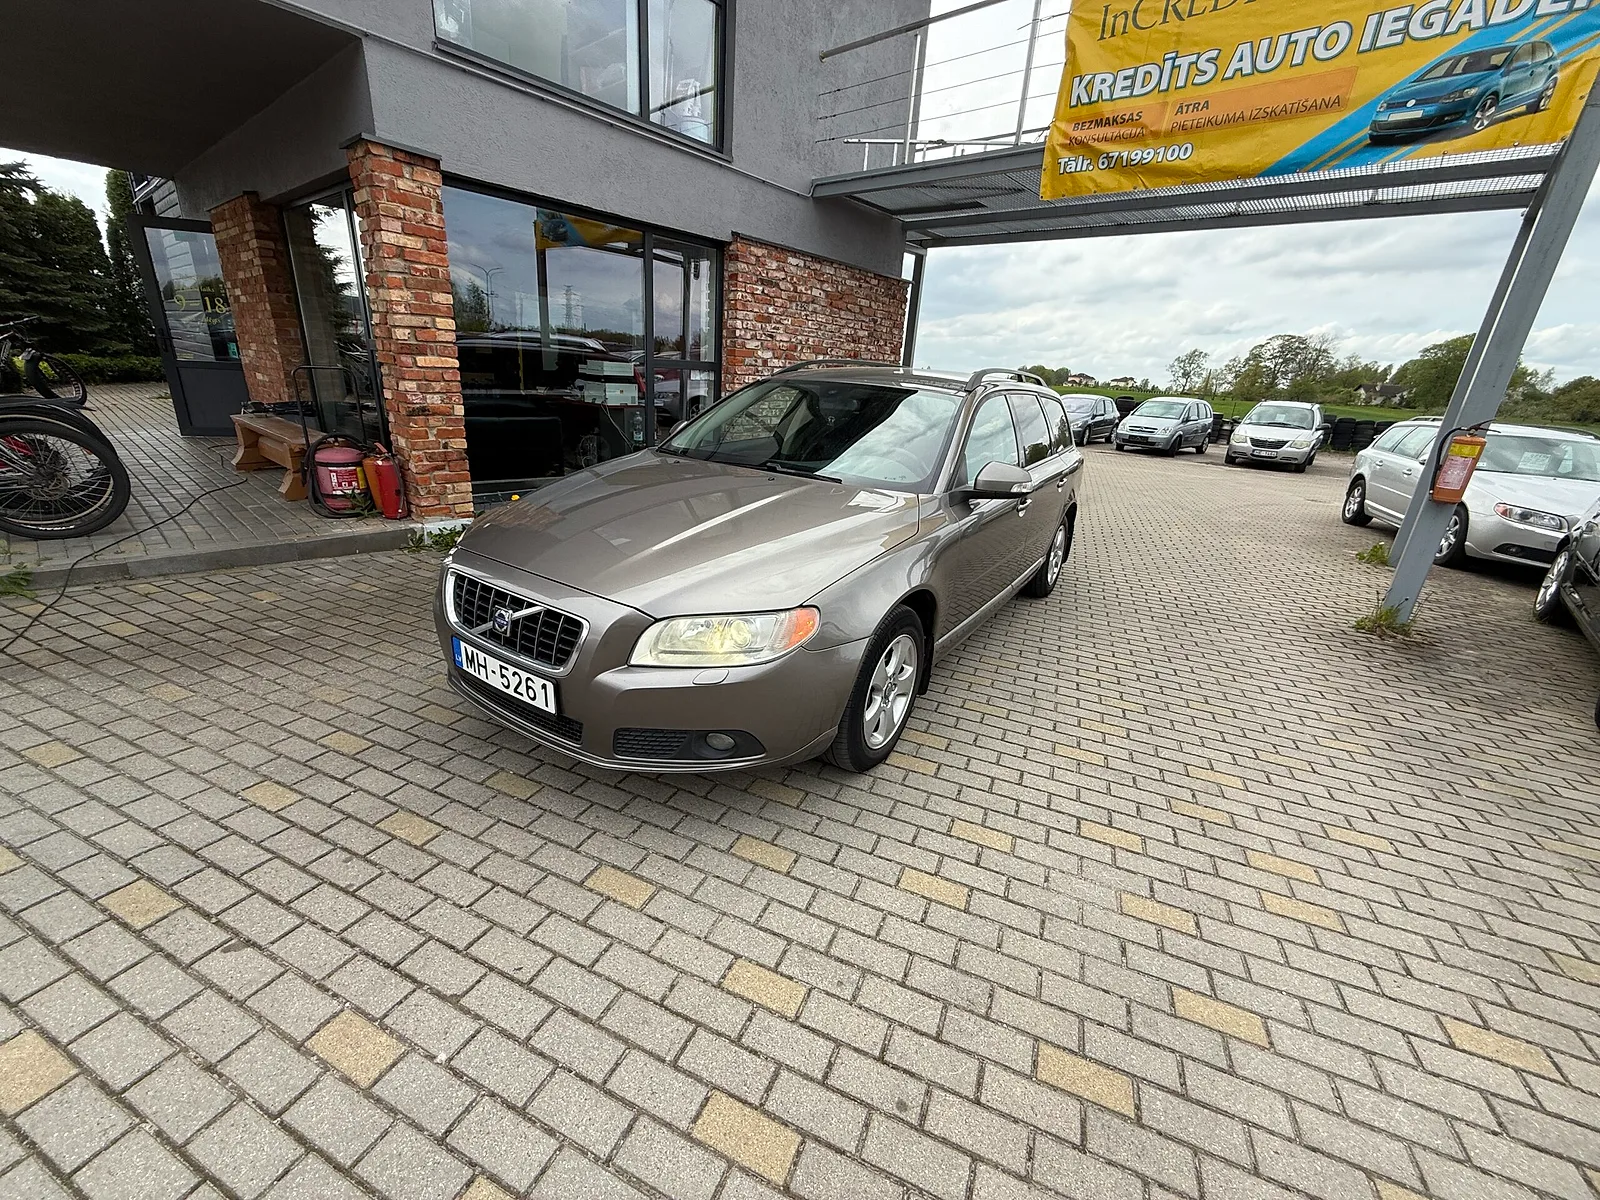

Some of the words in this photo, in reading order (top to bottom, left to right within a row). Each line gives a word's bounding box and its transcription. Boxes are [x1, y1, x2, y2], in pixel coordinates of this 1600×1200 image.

[1069, 49, 1221, 108] KREDĪTS
[1222, 20, 1353, 81] AUTO
[1072, 110, 1143, 132] BEZMAKSAS
[1170, 112, 1246, 133] PIETEIKUMA
[1248, 94, 1342, 122] IZSKATĪŠANA
[1174, 99, 1210, 116] ĀTRA
[1057, 155, 1095, 175] Tālr.
[1097, 142, 1194, 170] 67199100
[464, 645, 549, 708] MH-5261
